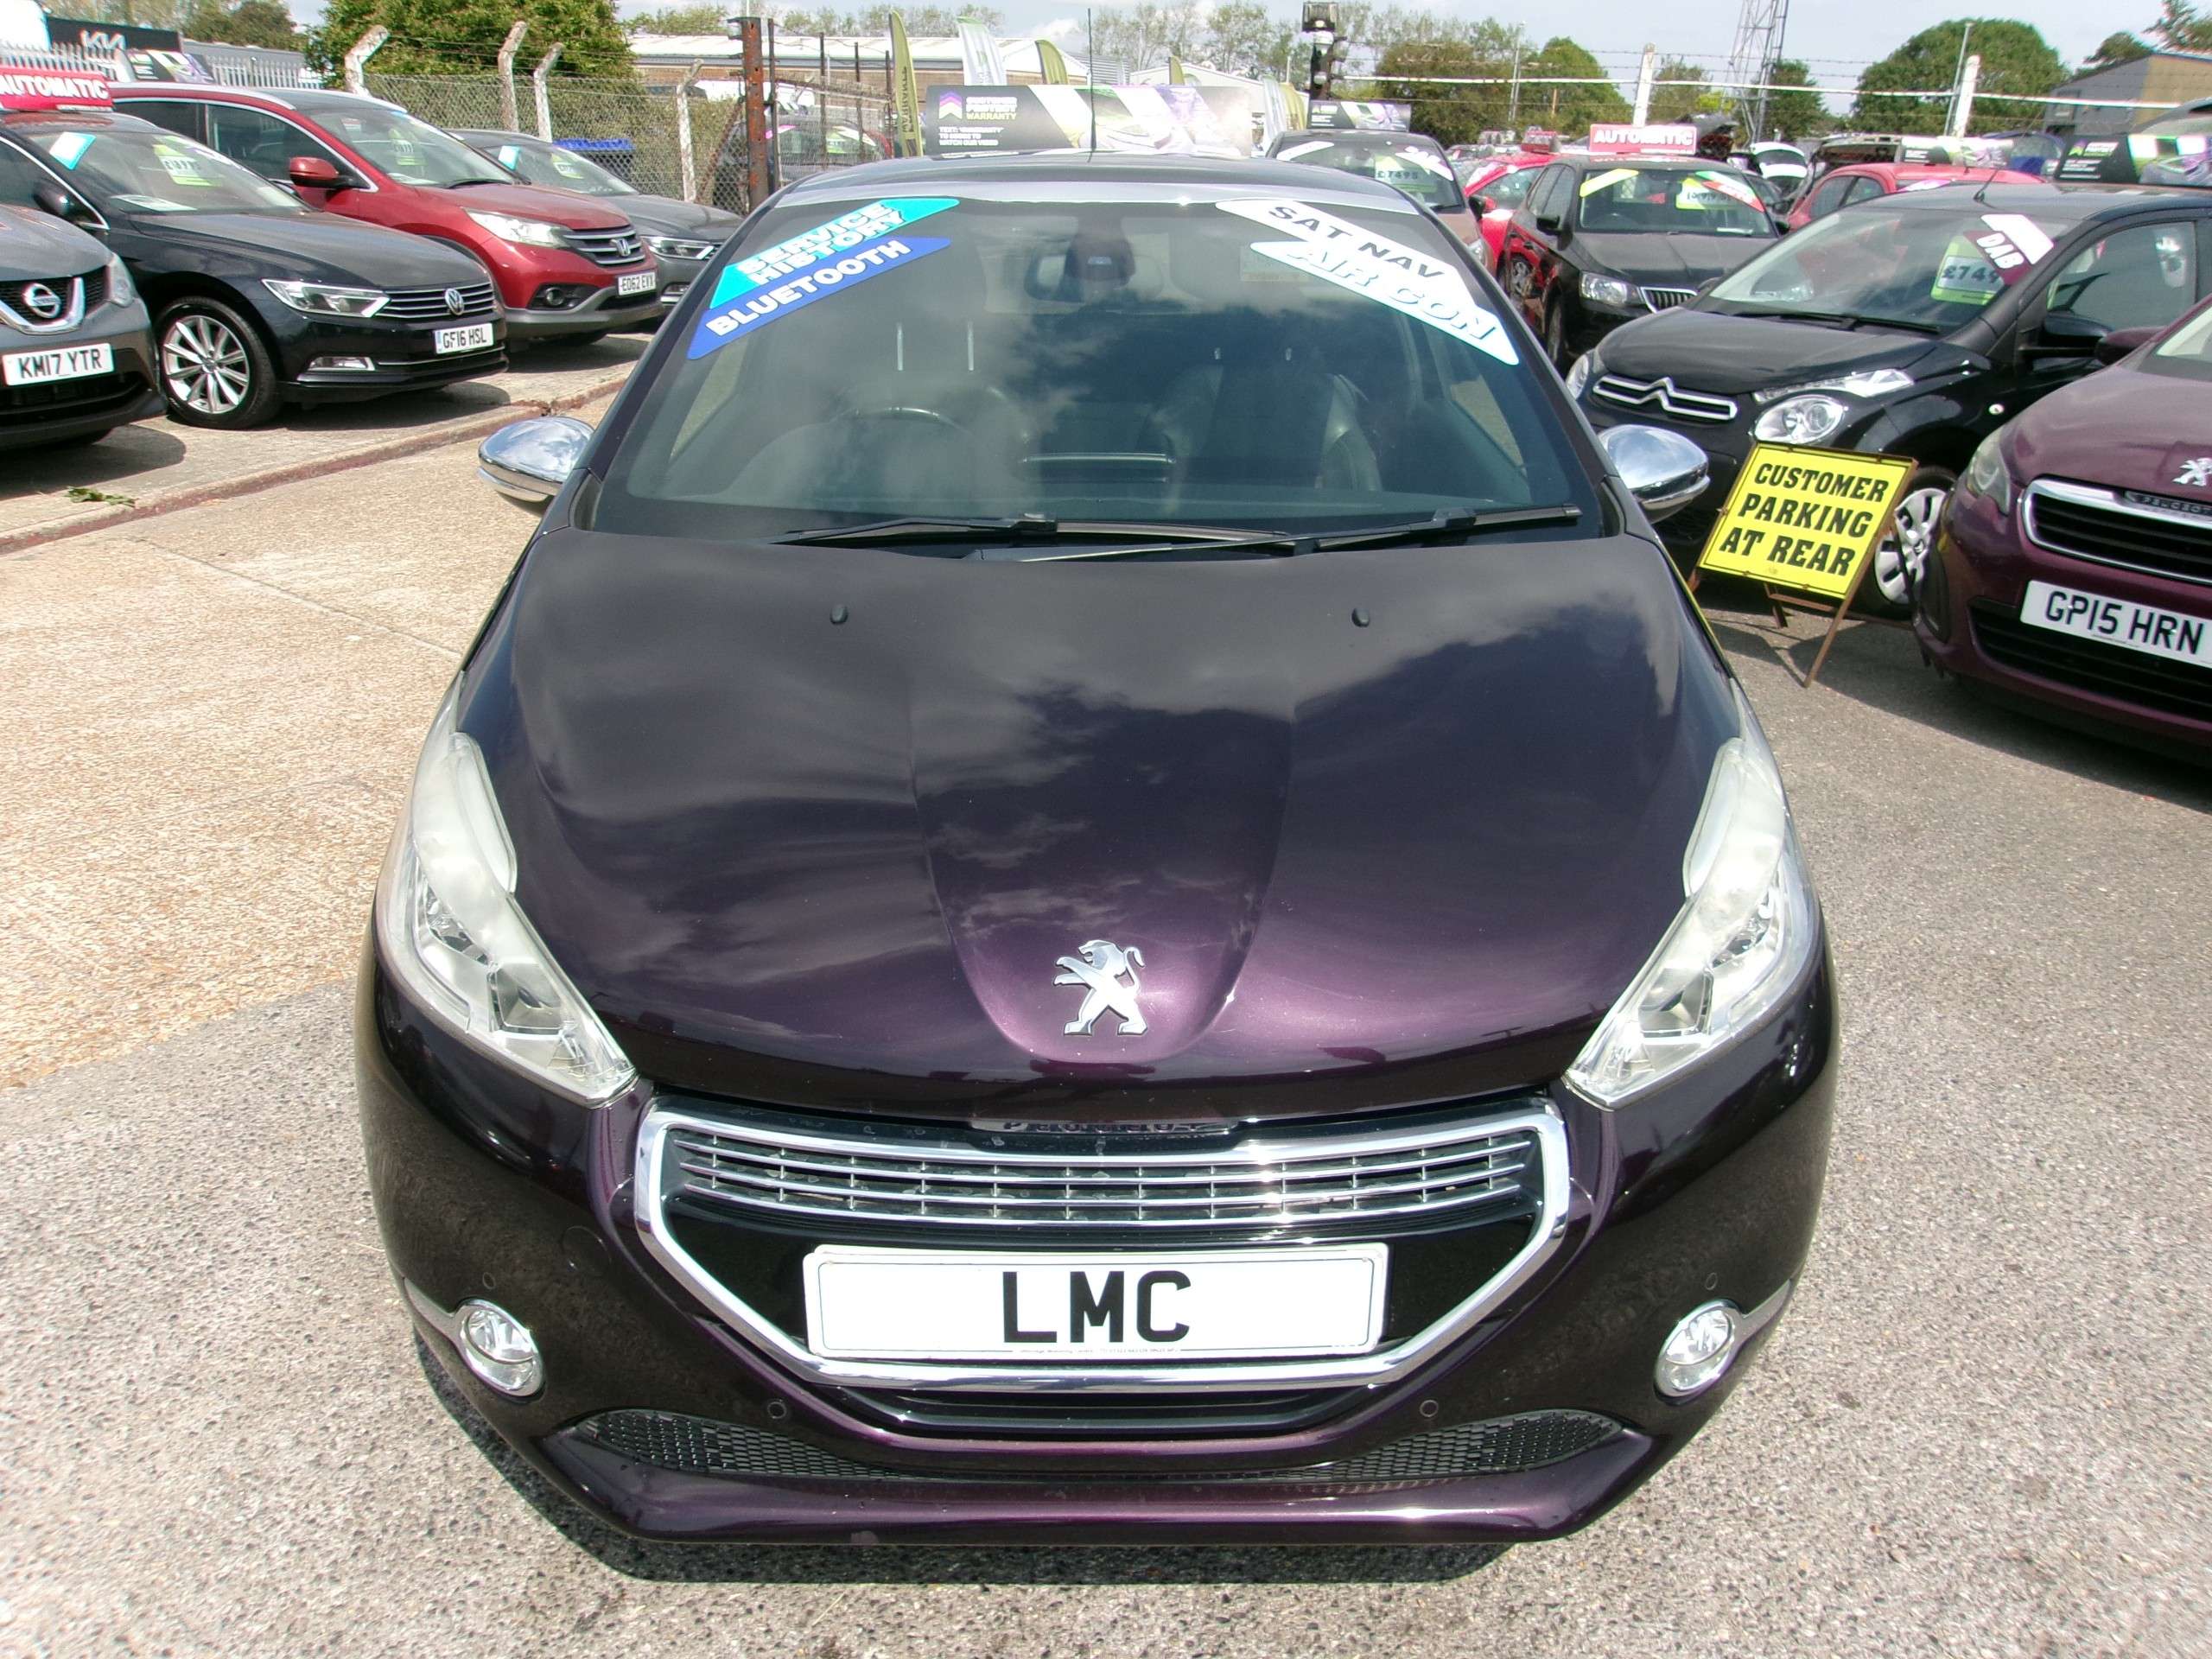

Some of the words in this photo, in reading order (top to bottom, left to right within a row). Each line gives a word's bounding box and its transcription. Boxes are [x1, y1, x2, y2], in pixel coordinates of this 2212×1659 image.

[1593, 129, 1694, 146] AUTOMATIC
[1268, 207, 1353, 239] SAT
[1357, 241, 1444, 279] NAV
[1976, 232, 2024, 270] DAB
[704, 239, 912, 337] BLUETOOTH
[442, 330, 467, 349] GF16
[468, 327, 487, 345] HSL
[17, 353, 62, 379] KM17
[67, 348, 103, 372] YTR
[1754, 463, 1889, 503] CUSTOMER
[1737, 493, 1873, 538] PARKING
[1719, 527, 1765, 557] AT
[1766, 535, 1856, 577] REAR
[2044, 590, 2122, 635] GP15
[2127, 608, 2204, 655] HRN
[1002, 1269, 1192, 1344] LMC
